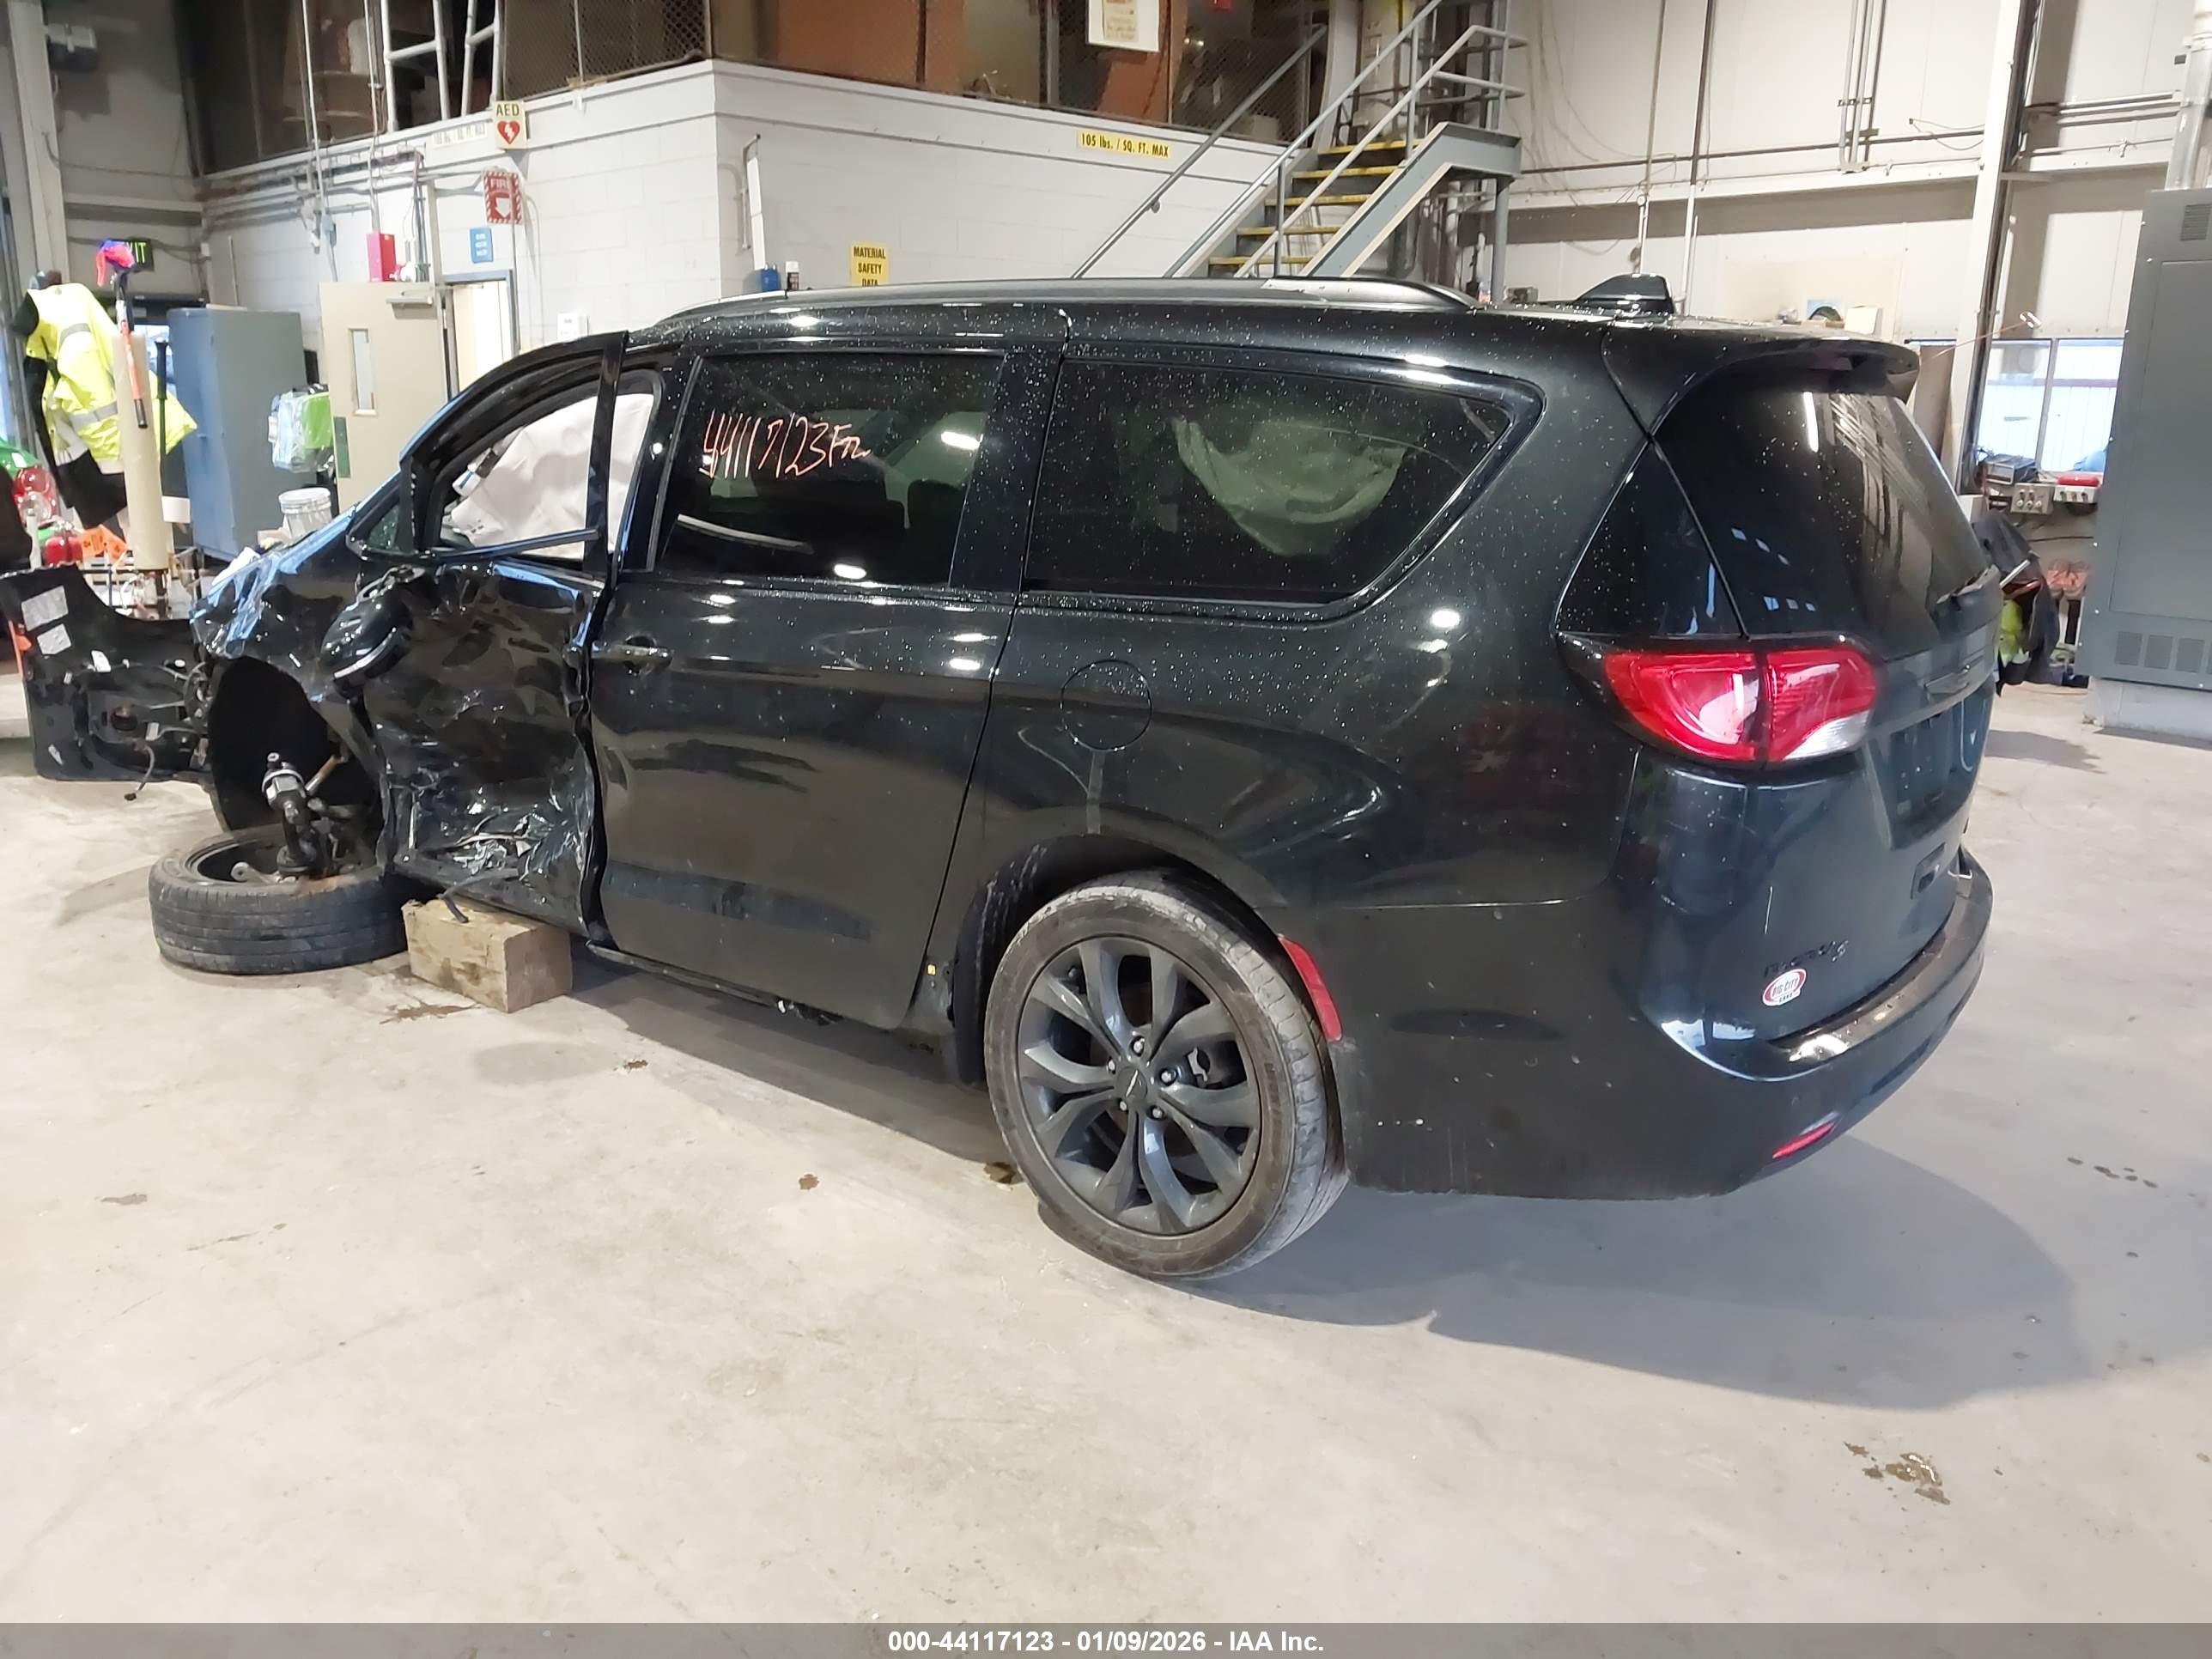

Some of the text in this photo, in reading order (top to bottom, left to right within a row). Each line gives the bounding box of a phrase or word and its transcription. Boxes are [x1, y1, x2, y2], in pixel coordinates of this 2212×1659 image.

[496, 103, 520, 117] AED
[1082, 132, 1097, 147] 105
[1099, 137, 1114, 149] lbs.
[1123, 139, 1135, 153] SQ.
[1139, 143, 1149, 155] FT.
[1152, 143, 1169, 157] MAX
[854, 246, 886, 259] MATERIAL
[859, 262, 882, 275] SAFETY
[861, 277, 878, 288] DATA
